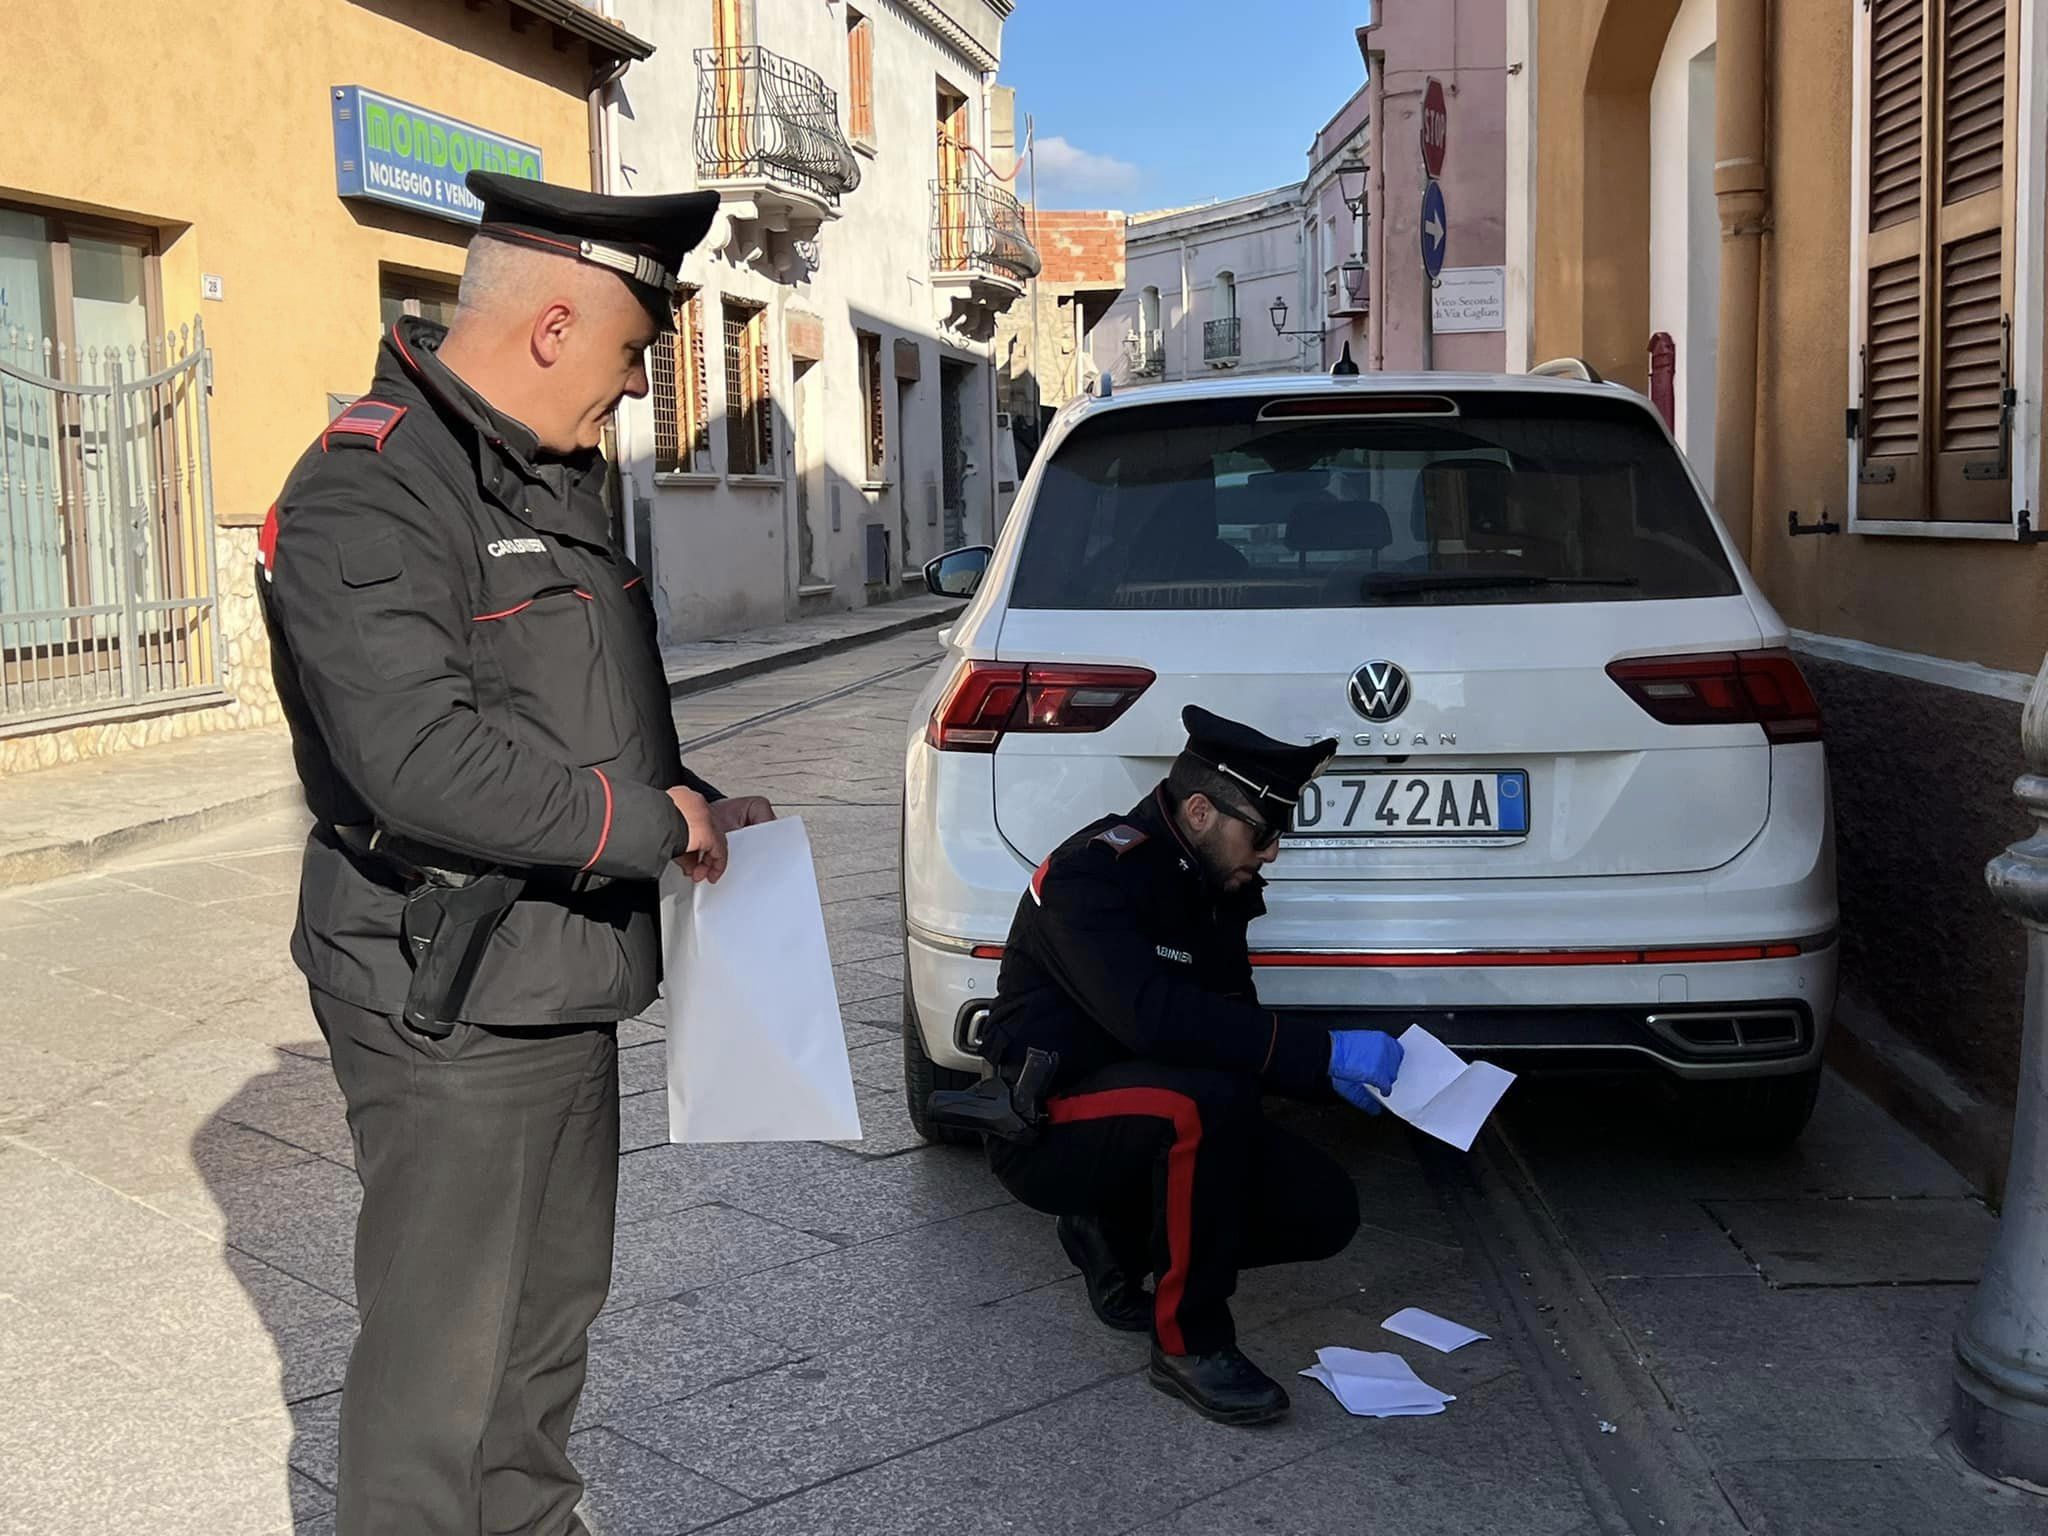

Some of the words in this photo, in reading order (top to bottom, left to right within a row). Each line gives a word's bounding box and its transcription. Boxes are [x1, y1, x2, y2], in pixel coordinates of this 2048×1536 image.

[1425, 107, 1446, 150] STOP
[369, 160, 432, 198] NOLEGGIO
[435, 184, 442, 201] E
[1434, 297, 1456, 307] Vico
[1459, 296, 1499, 306] Secondo
[1443, 308, 1460, 318] Via
[1463, 307, 1499, 320] Cagliari
[1341, 779, 1492, 827] 742AA
